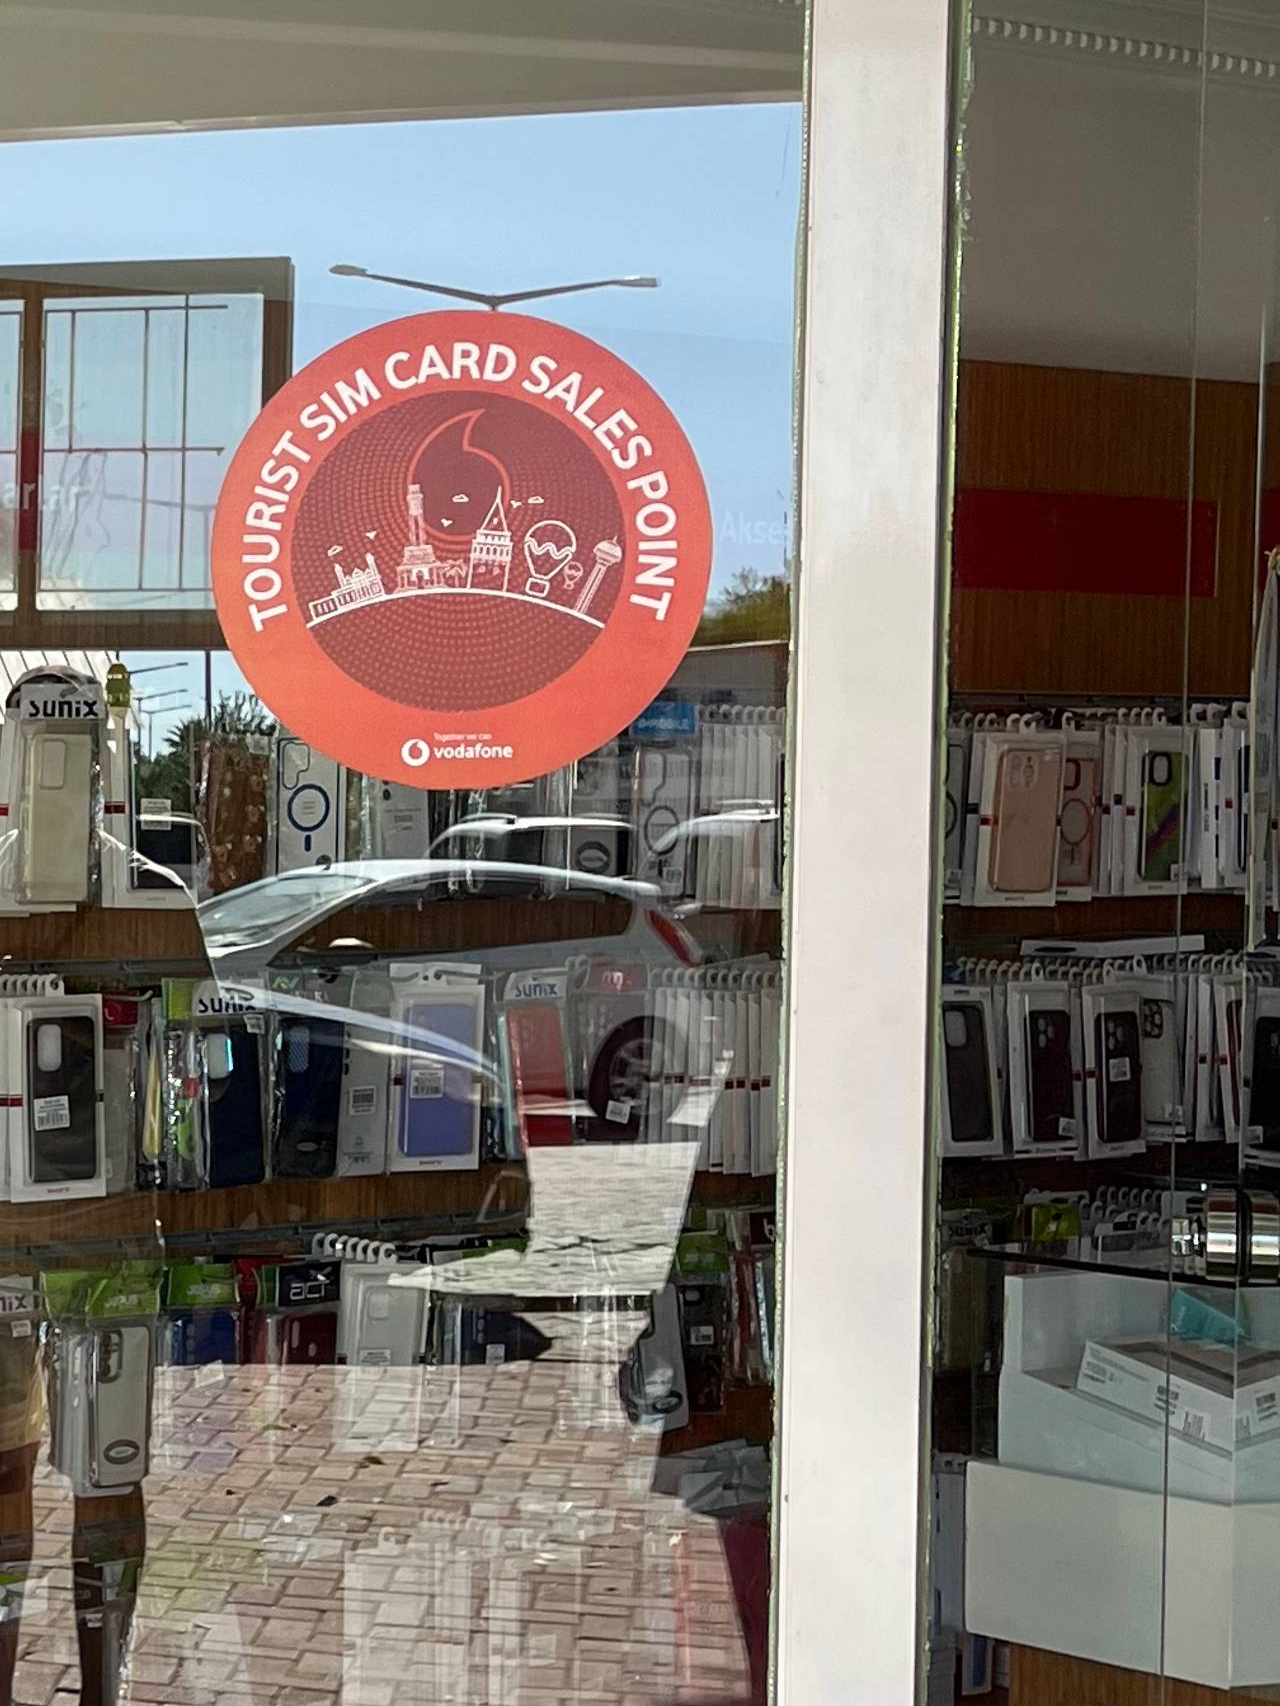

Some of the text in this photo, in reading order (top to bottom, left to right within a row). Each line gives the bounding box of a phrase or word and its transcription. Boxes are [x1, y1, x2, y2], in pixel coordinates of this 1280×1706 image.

[241, 341, 678, 632] TOURIST SIM CARD SALES POINT
[433, 742, 513, 759] vodafone
